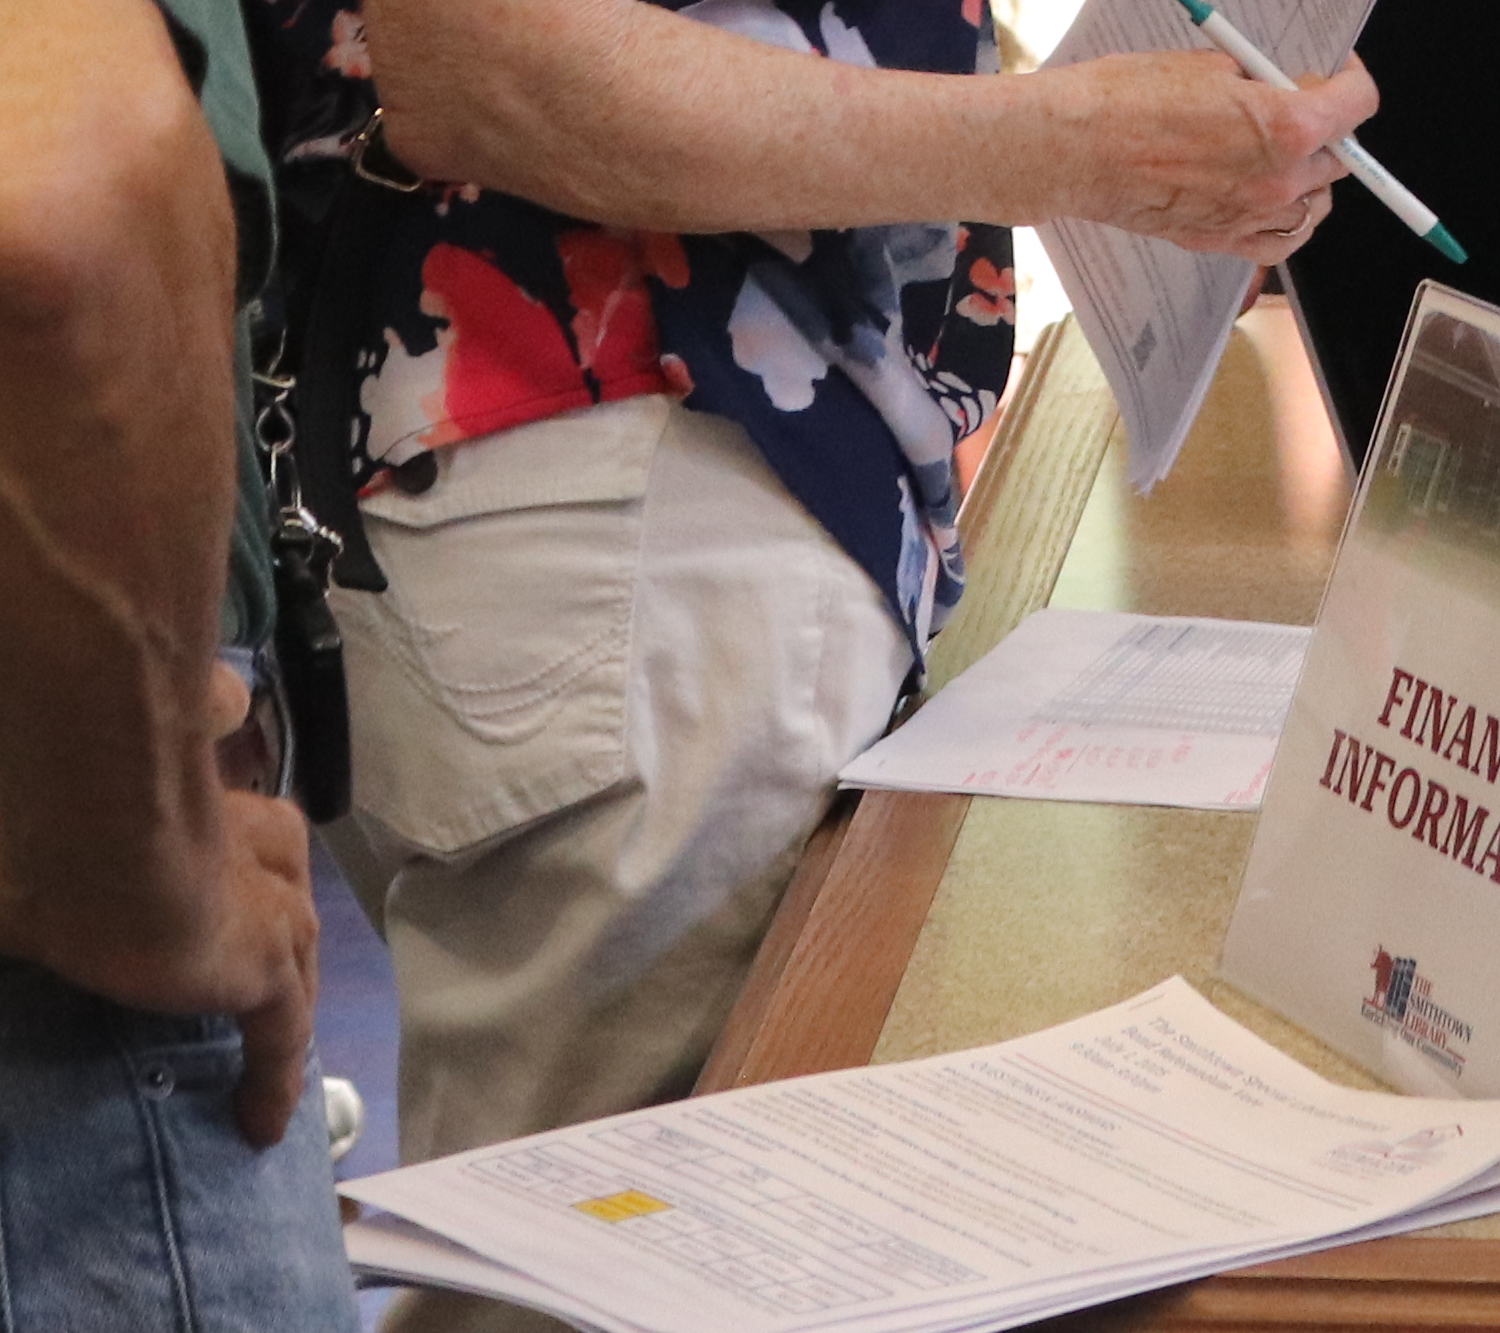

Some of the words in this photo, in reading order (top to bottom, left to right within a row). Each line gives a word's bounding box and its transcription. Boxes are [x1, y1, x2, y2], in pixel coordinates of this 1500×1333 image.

[1414, 973, 1433, 996] THE
[1403, 1011, 1447, 1049] LIBRARY
[1409, 993, 1473, 1044] SMITHTOWN
